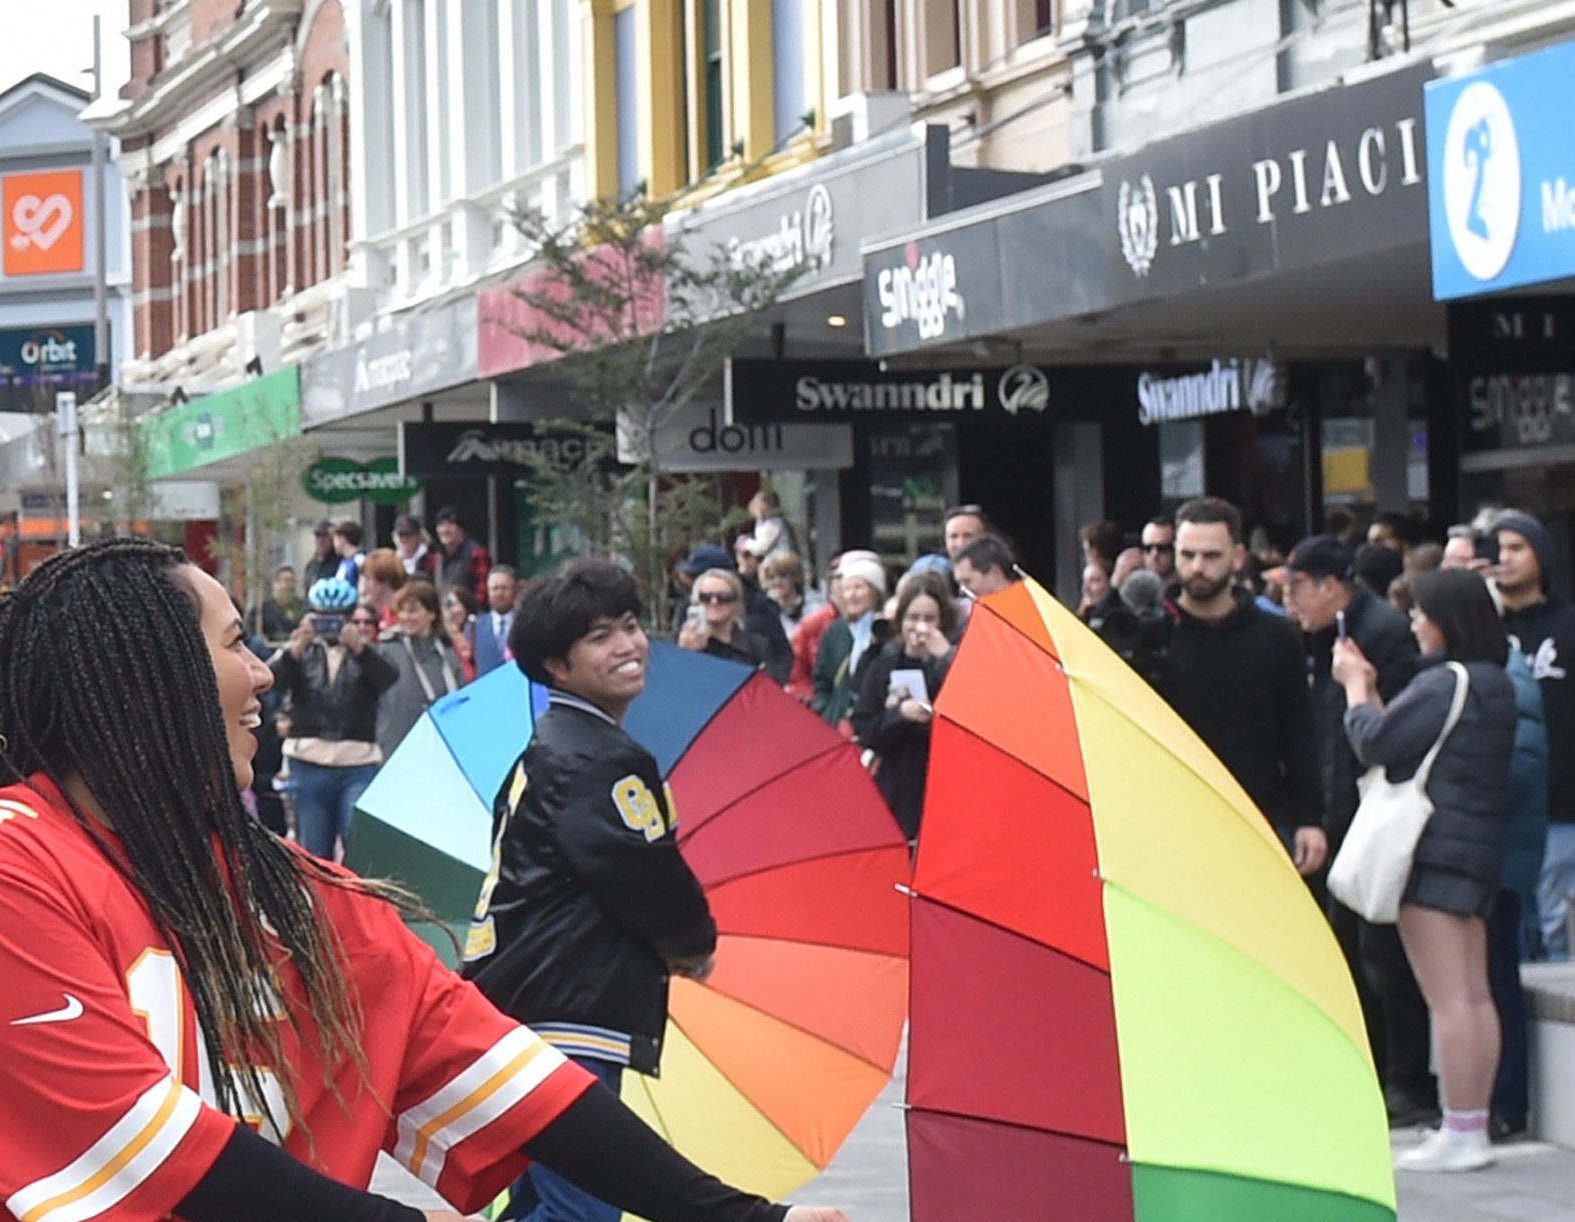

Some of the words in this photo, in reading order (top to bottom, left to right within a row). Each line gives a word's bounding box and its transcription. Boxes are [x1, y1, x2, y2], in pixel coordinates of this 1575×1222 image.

[1167, 174, 1227, 246] MI
[1253, 117, 1422, 224] PIACI
[795, 373, 985, 411] Swanndri
[1138, 357, 1240, 426] Swanndri
